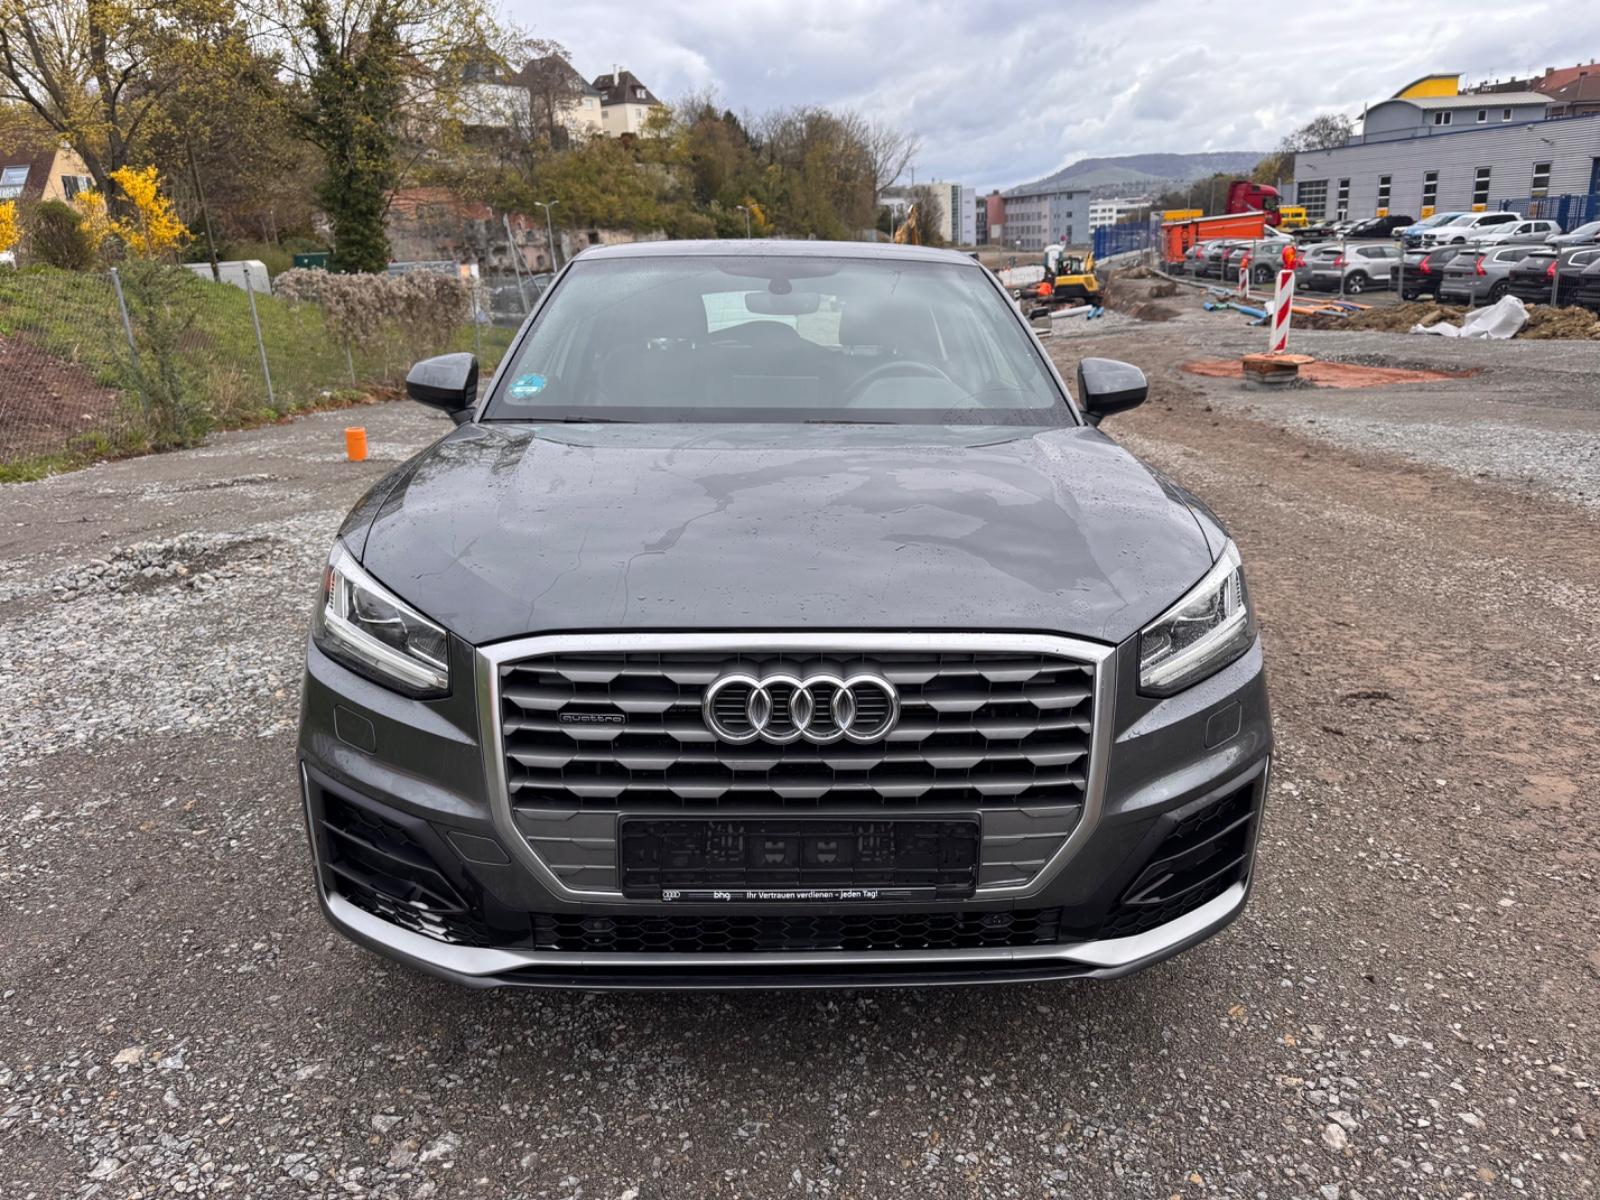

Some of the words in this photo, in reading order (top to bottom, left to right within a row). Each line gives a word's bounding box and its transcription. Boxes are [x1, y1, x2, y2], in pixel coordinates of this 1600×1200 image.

[562, 714, 622, 723] quattro
[713, 890, 731, 901] bhg
[746, 891, 757, 899] Ihr
[758, 891, 795, 899] Vertrauen
[796, 890, 833, 899] verdienen
[840, 890, 862, 900] jeden
[863, 890, 878, 899] Tag!
